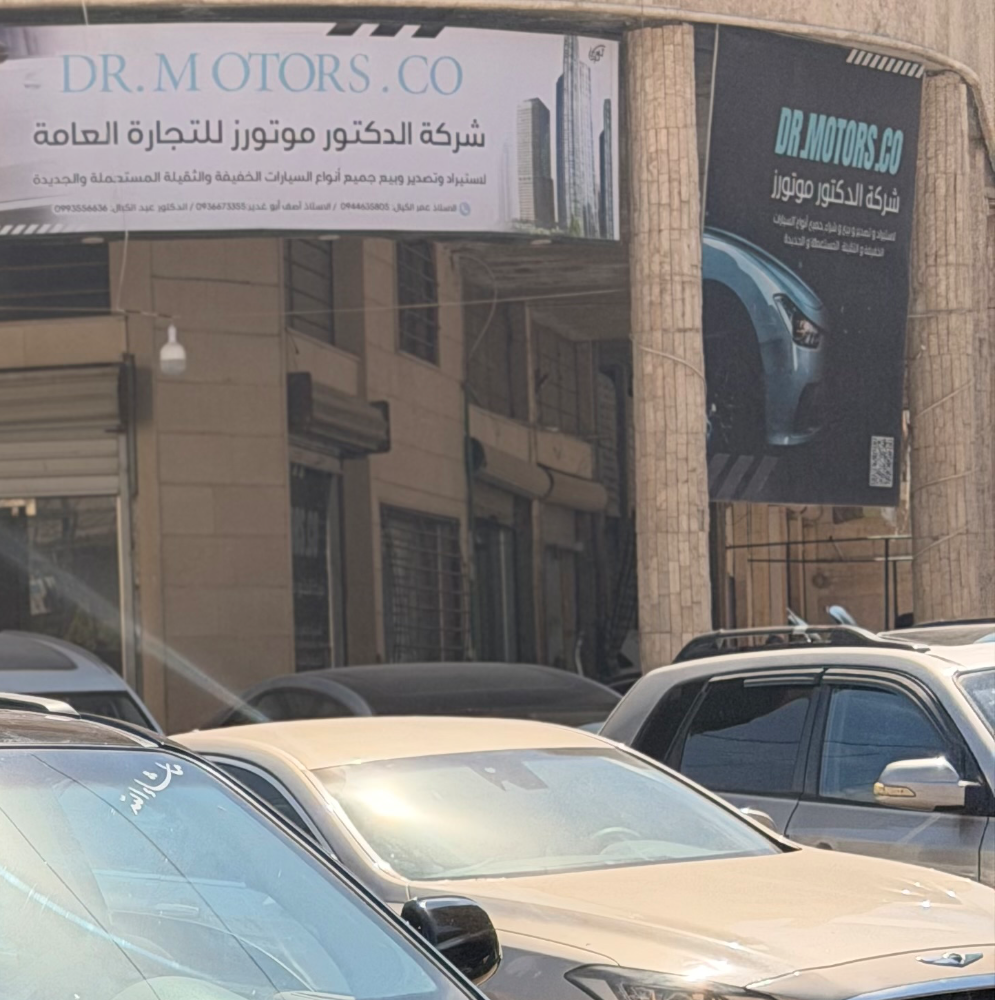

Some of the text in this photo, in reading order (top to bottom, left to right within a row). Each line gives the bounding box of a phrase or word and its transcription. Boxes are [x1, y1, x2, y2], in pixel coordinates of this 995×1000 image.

[33, 119, 485, 153] شركة الدكتور موتورز للتجارة العامة
[33, 172, 87, 187] والجديدة
[90, 171, 161, 185] المستعملة
[164, 168, 212, 185] والثقيلة
[215, 170, 262, 185] الخفيفة
[264, 170, 313, 186] السيارات
[315, 167, 341, 186] أنواع
[343, 173, 376, 186] جميع
[378, 174, 405, 186] وبيع
[407, 172, 444, 187] وتصدير
[771, 169, 900, 216] شركة الدكتور موتورز
